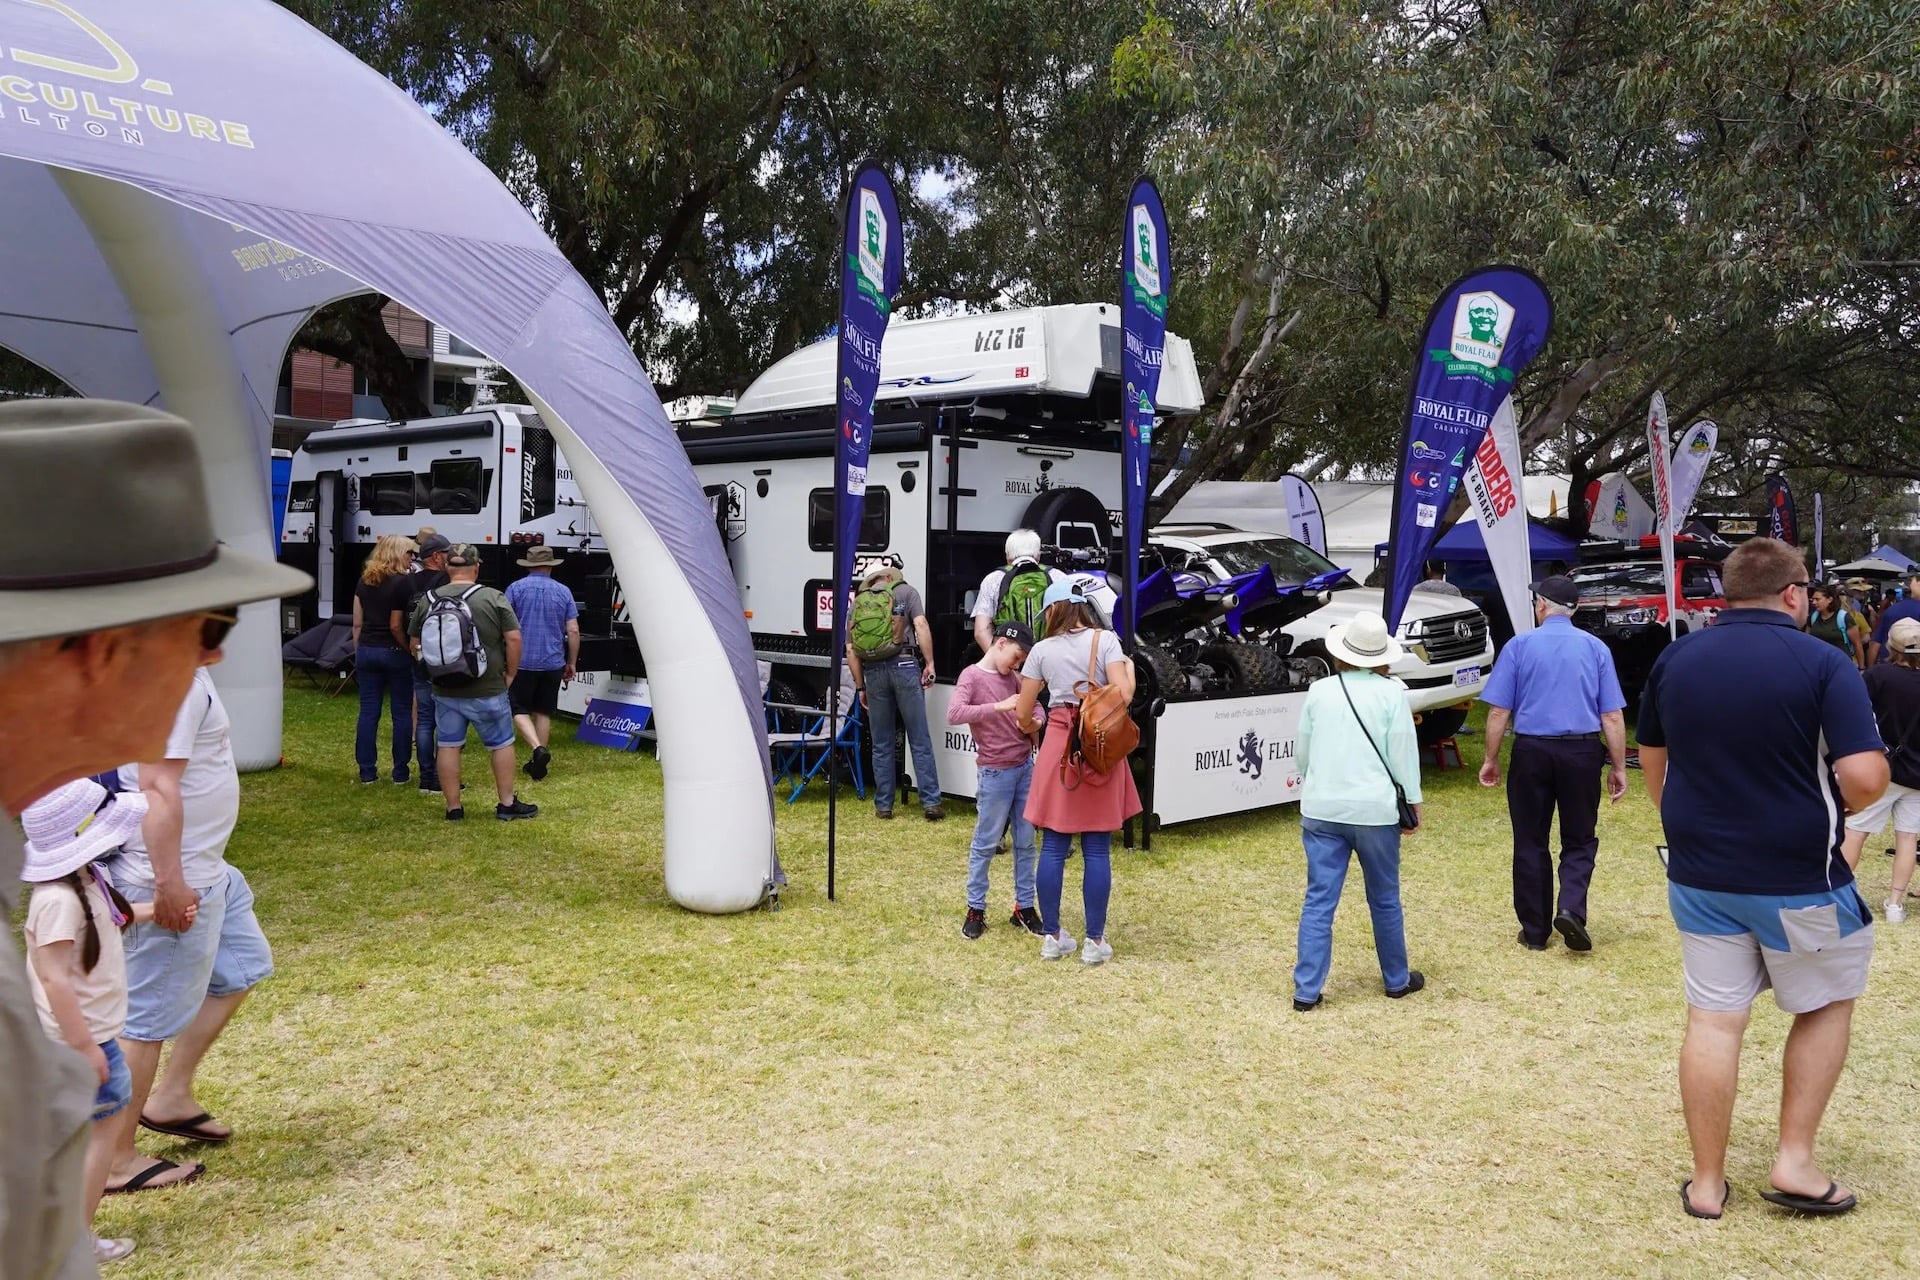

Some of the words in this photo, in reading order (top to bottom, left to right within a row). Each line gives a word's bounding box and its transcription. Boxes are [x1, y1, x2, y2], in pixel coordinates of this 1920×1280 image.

[0, 75, 254, 148] CULTURE
[0, 102, 144, 146] LTON
[974, 328, 1004, 353] 274
[1455, 342, 1478, 356] ROYAL
[1418, 399, 1456, 421] ROYAL
[1455, 408, 1488, 429] FLAIR
[1005, 480, 1032, 494] ROYAL
[1474, 485, 1496, 529] BRAKES
[1006, 628, 1018, 637] 63
[1195, 748, 1233, 772] ROYAL
